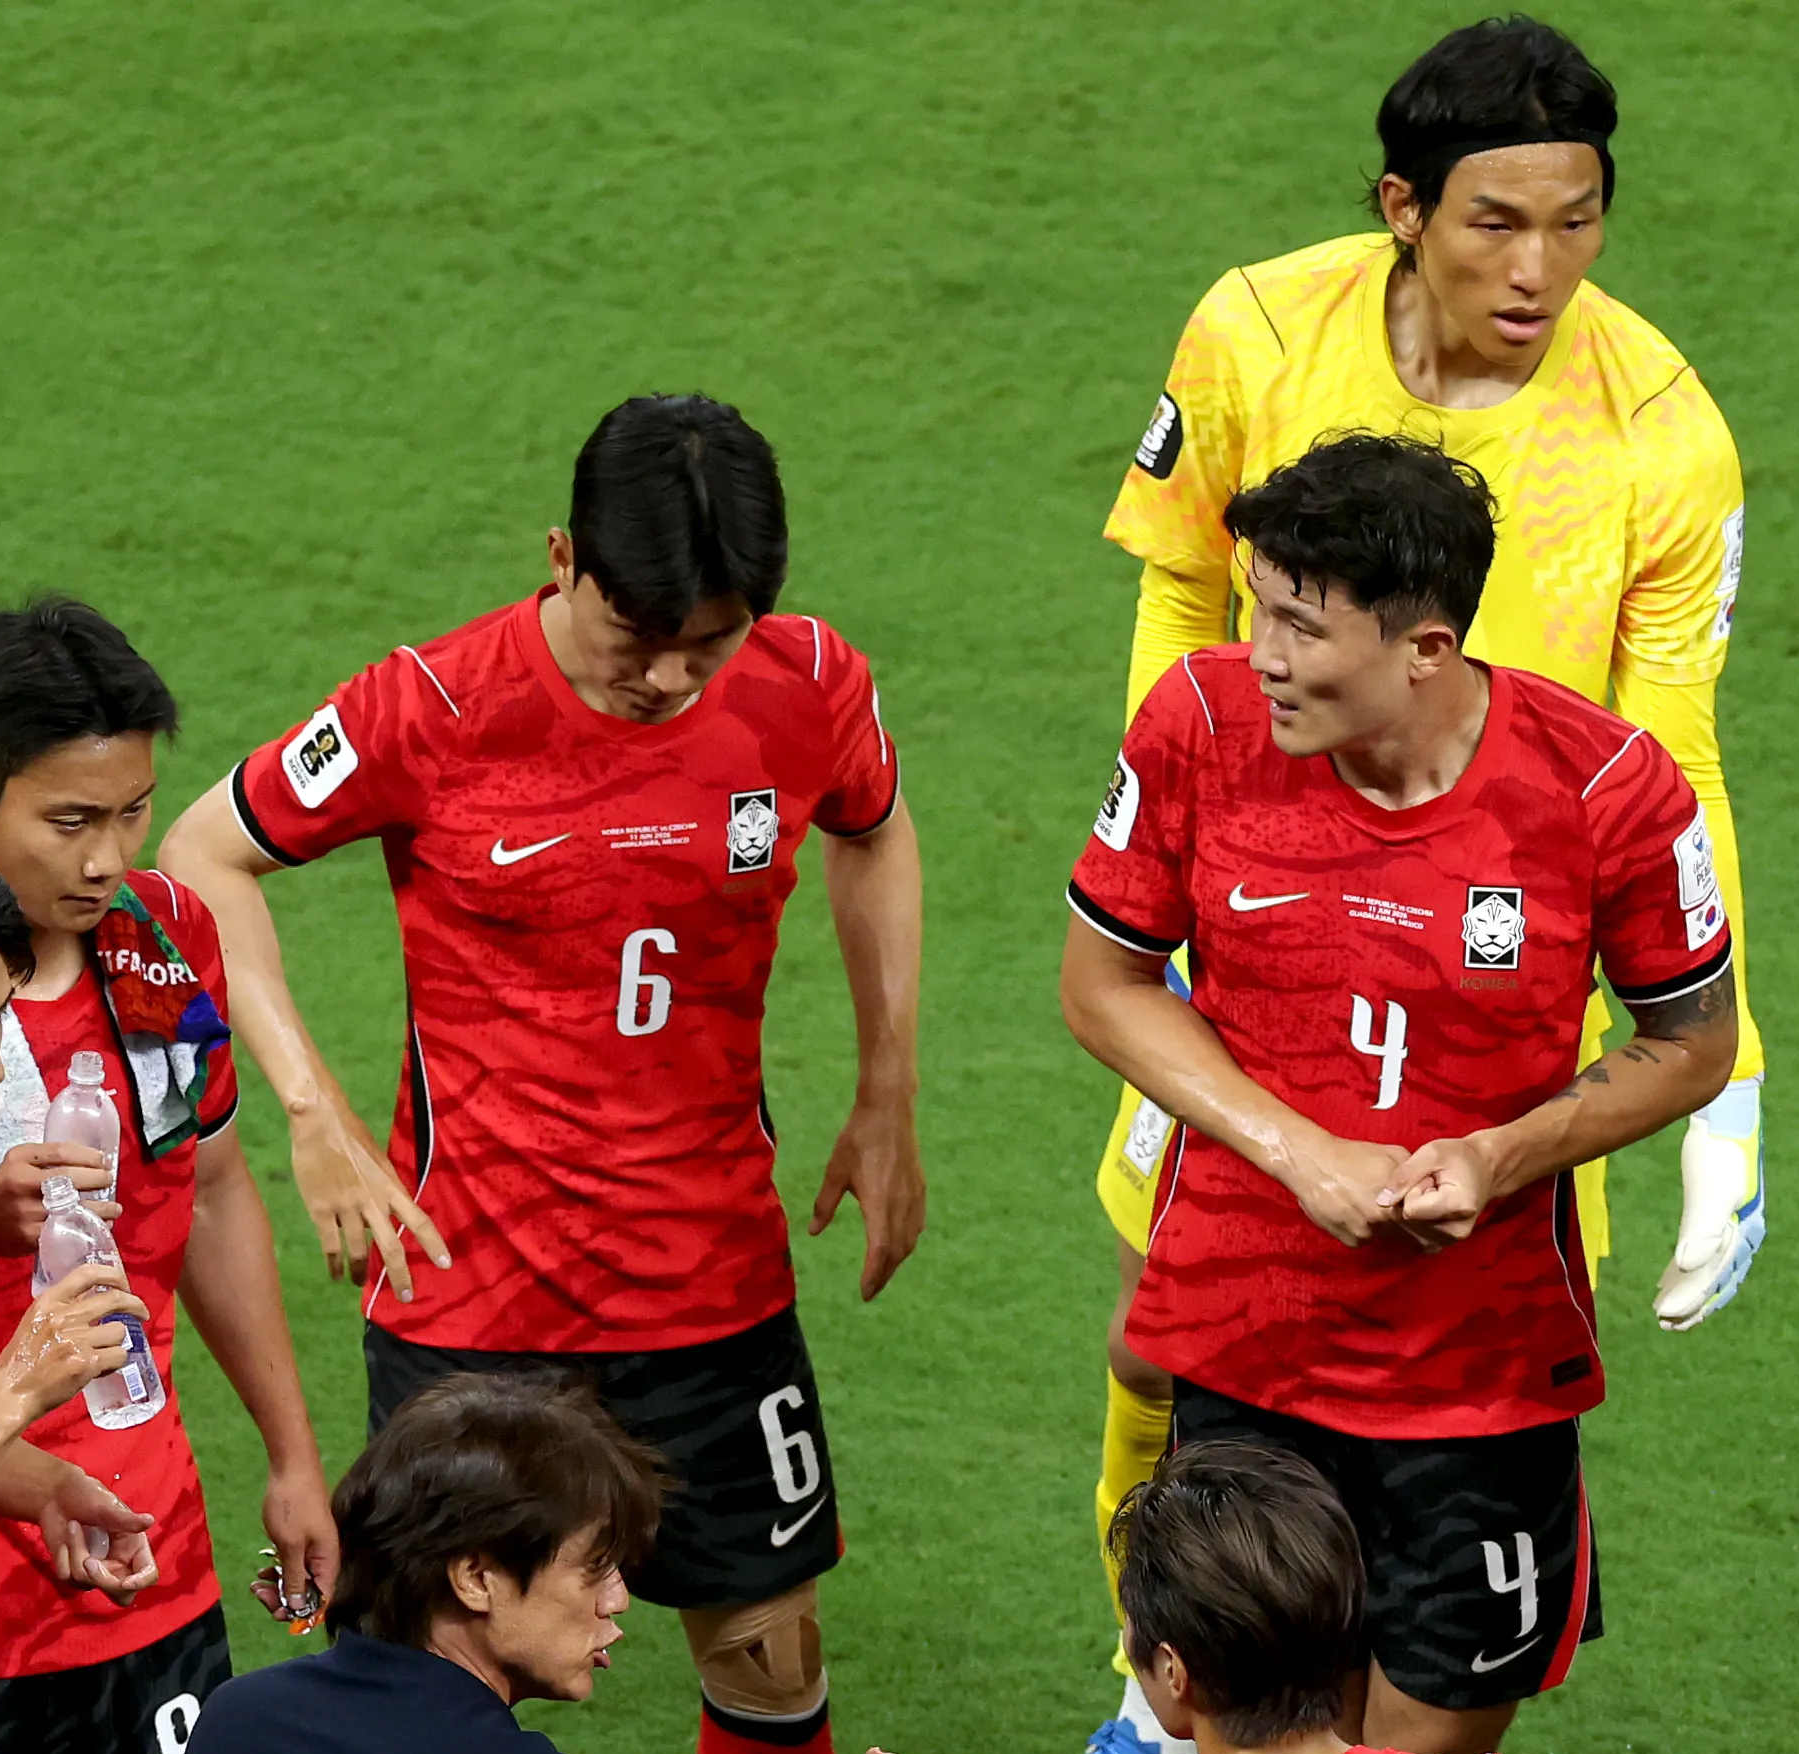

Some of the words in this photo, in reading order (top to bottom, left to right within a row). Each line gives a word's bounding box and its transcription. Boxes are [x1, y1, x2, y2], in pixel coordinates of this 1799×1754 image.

[1342, 894, 1365, 904] KOREA
[1366, 897, 1398, 909] REPUBLIC
[1406, 905, 1434, 918] CZECHIA
[1378, 907, 1392, 916] JUN
[1392, 909, 1408, 919] 2026
[1399, 919, 1424, 930] MEXICO
[617, 928, 680, 1036] 6
[1459, 975, 1518, 991] KOREA
[1350, 993, 1408, 1111] 4
[758, 1384, 822, 1504] 6
[1481, 1531, 1539, 1639] 4
